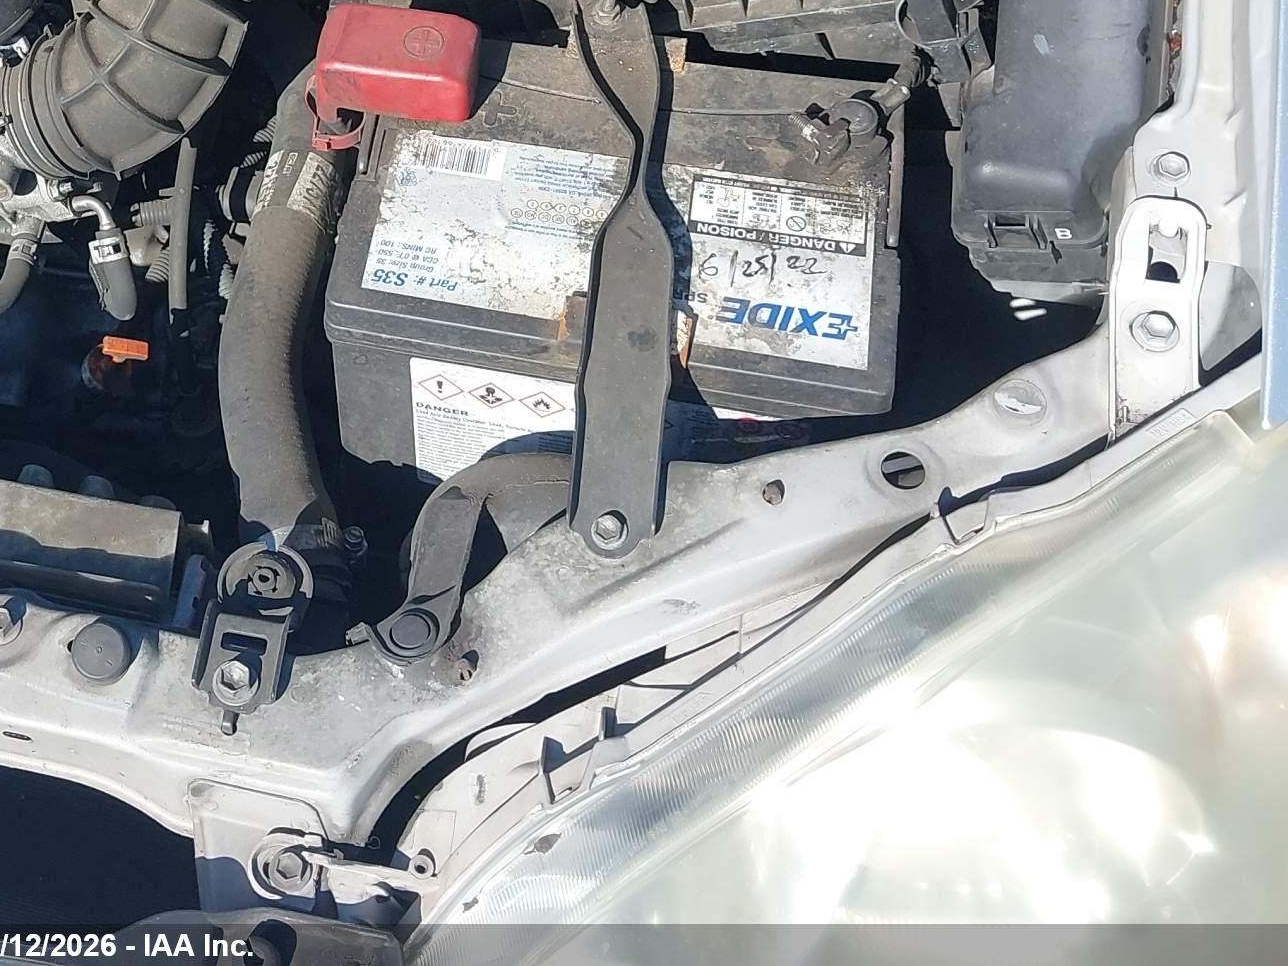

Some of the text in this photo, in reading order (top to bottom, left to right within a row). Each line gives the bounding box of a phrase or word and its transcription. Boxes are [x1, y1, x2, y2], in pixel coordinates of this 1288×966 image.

[696, 222, 758, 241] POISON
[1055, 228, 1072, 239] B
[767, 231, 836, 251] DANGER
[409, 262, 434, 273] Group
[422, 256, 439, 264] CCA
[371, 268, 409, 287] S35
[429, 278, 458, 291] Part
[715, 296, 859, 341] EXIDE
[415, 402, 469, 417] DANGER
